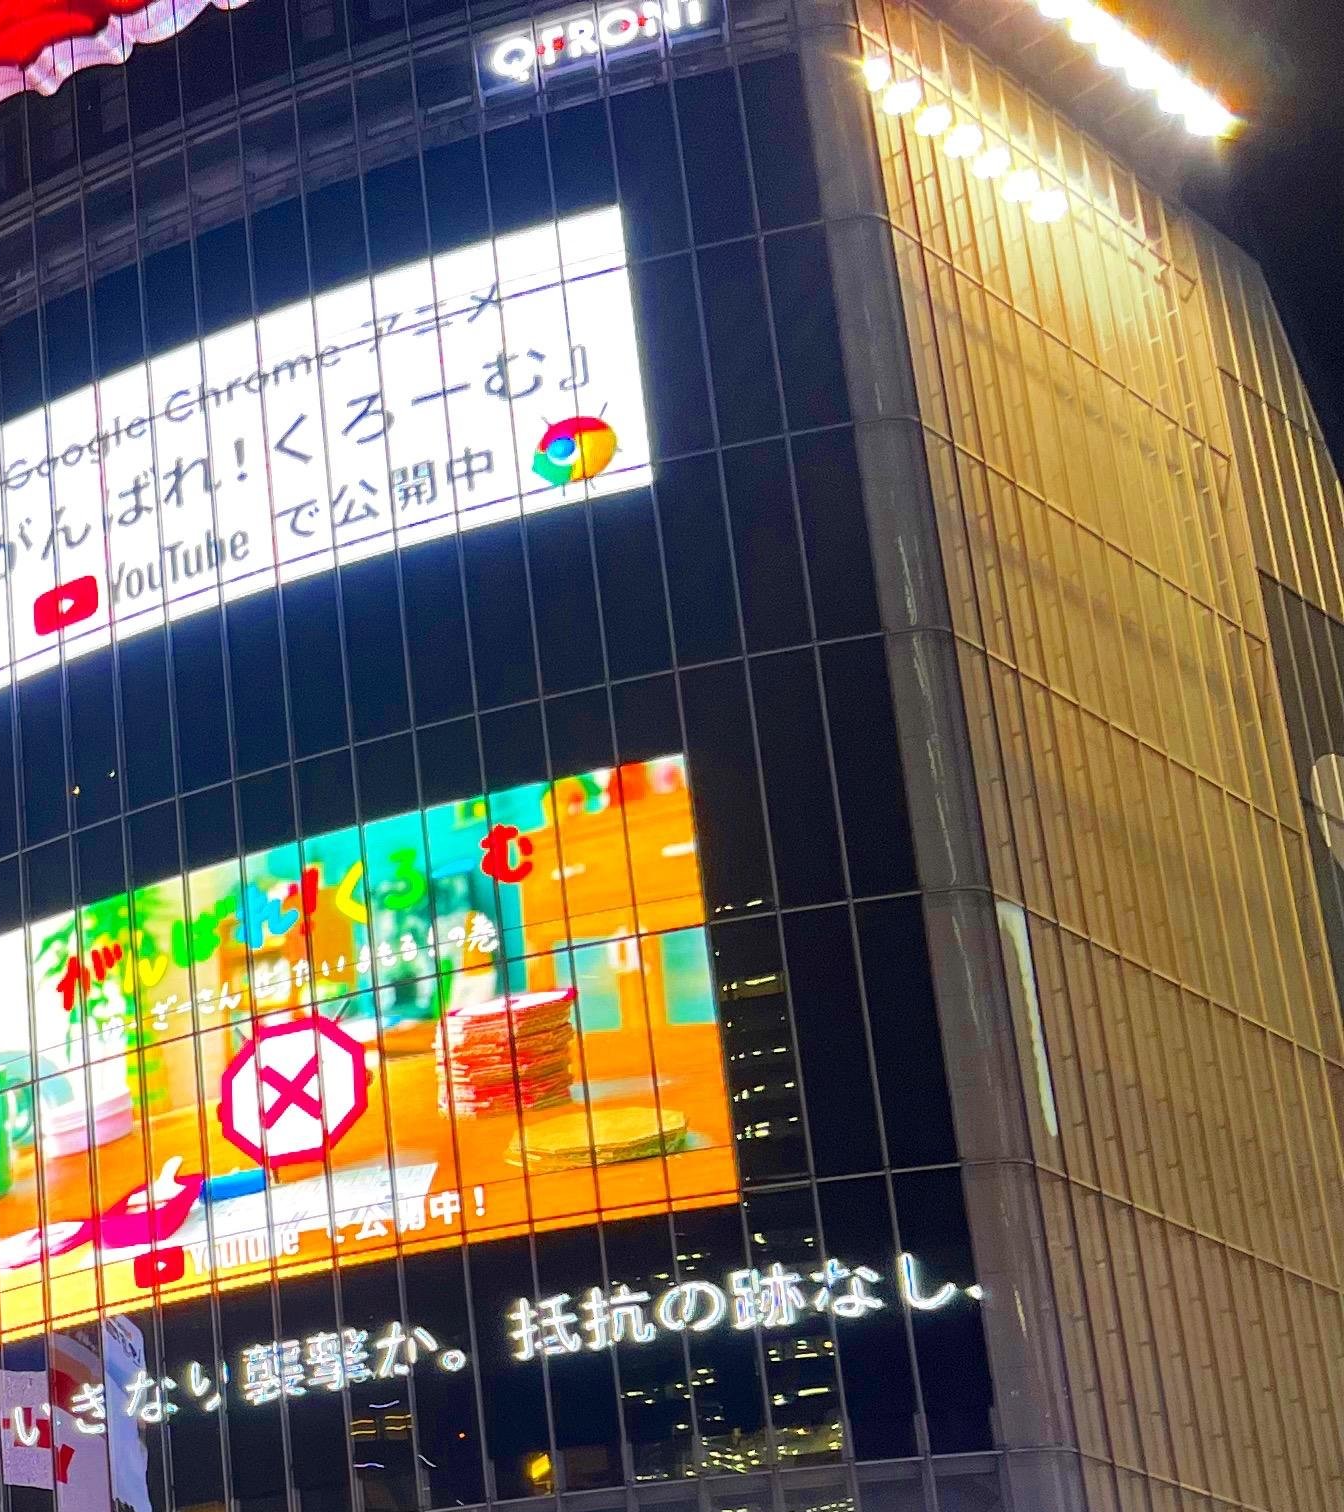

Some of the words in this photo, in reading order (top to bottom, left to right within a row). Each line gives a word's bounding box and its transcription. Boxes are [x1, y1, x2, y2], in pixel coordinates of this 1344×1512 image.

[4, 412, 148, 491] Google
[163, 342, 341, 422] Chrome
[360, 283, 504, 352] アニメ
[106, 525, 252, 604] YouTube
[275, 445, 496, 540] で公開中
